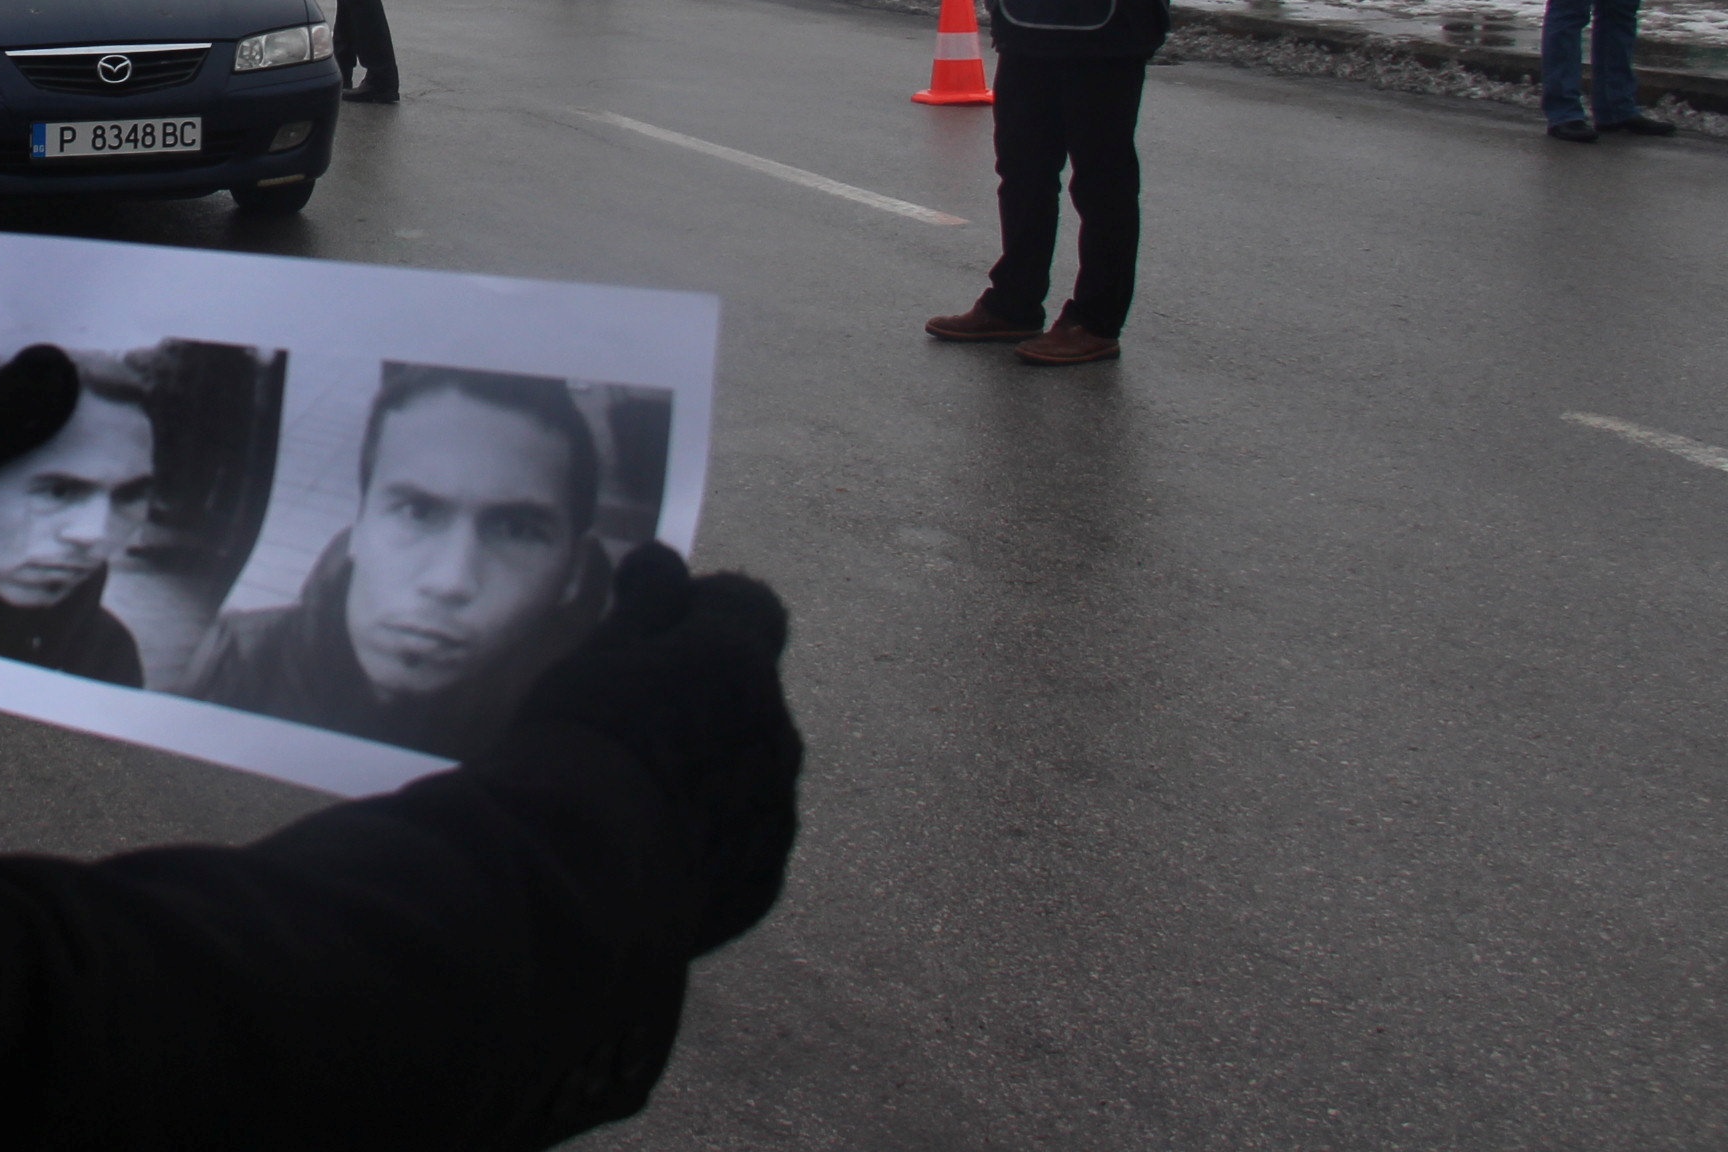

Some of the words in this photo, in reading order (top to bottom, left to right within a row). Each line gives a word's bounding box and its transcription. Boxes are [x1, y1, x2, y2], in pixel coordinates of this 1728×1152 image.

[59, 126, 77, 153] P
[91, 123, 156, 151] 8348
[162, 121, 196, 148] BC
[33, 144, 45, 153] BG
